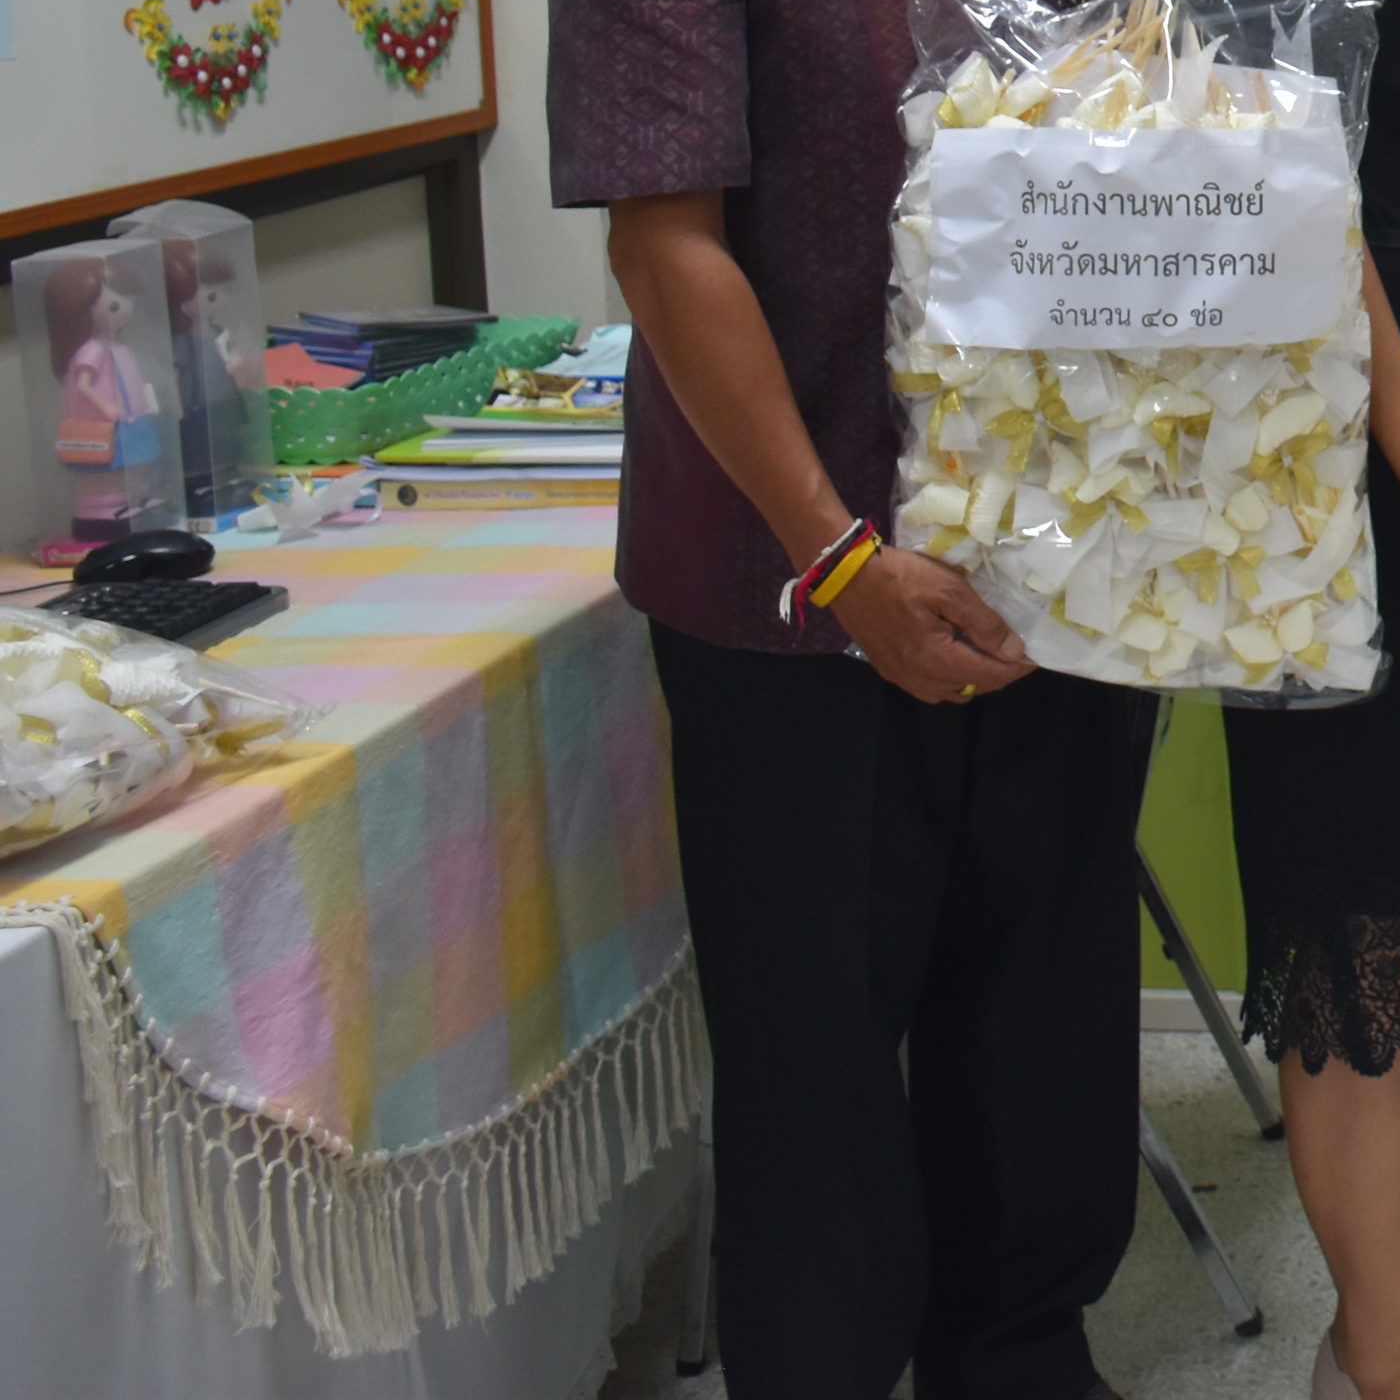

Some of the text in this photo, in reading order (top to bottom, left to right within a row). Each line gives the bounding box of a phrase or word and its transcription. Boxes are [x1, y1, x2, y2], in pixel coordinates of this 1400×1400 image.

[1020, 179, 1266, 217] สำนักงานพาณิชย์
[1009, 237, 1277, 278] จังหวัดมหาสารคาม
[1048, 298, 1131, 328] จำนวน
[1189, 299, 1224, 328] ช่อ
